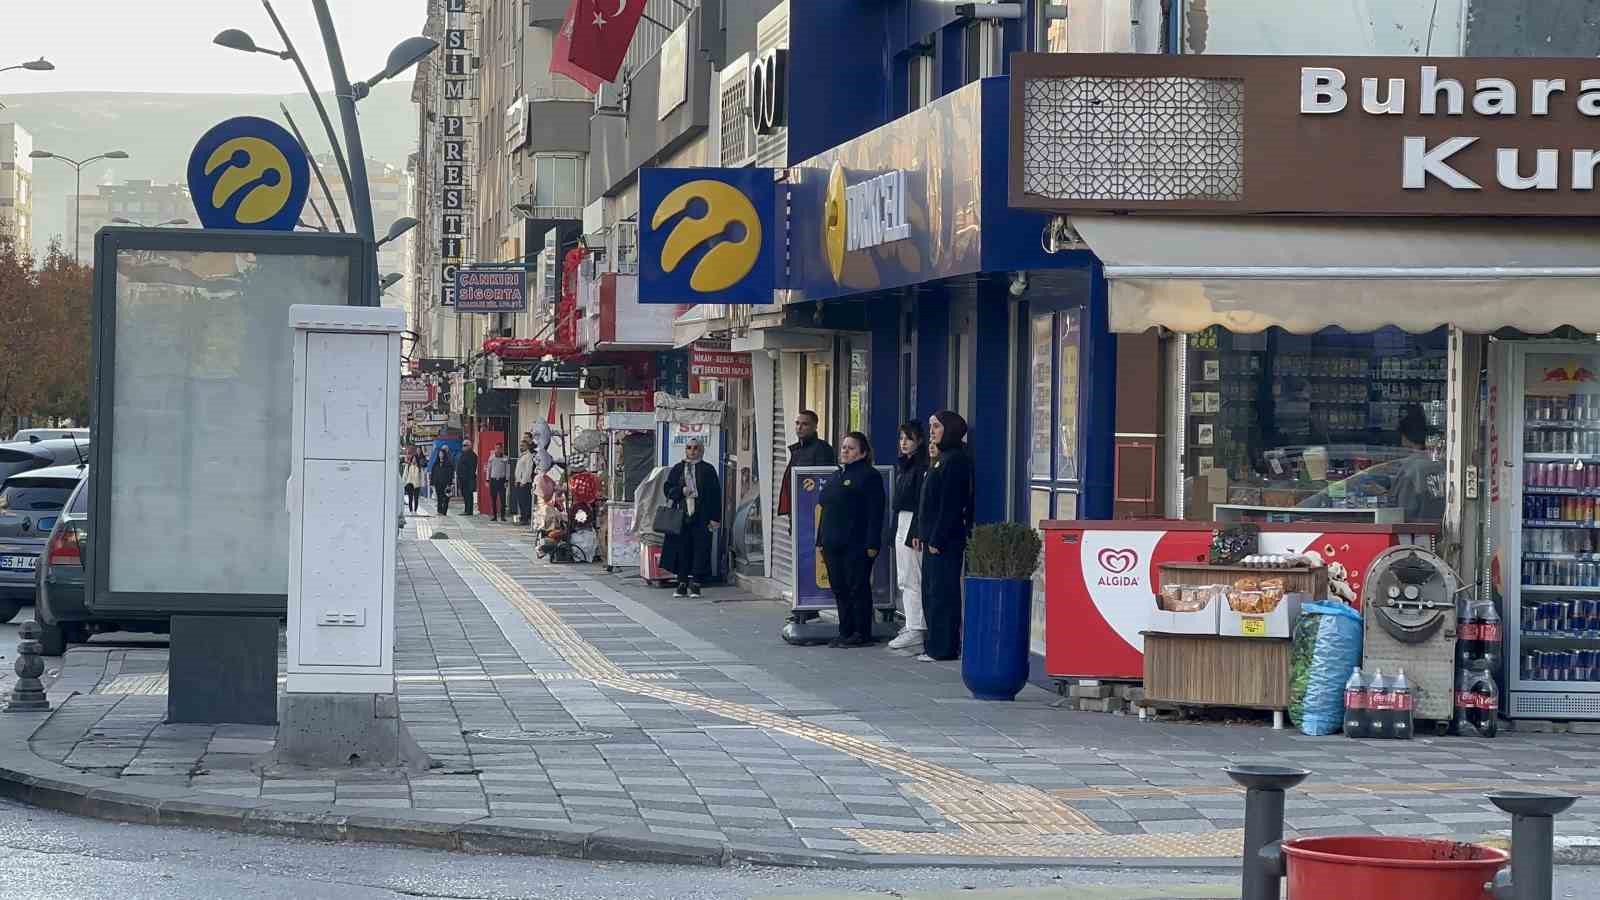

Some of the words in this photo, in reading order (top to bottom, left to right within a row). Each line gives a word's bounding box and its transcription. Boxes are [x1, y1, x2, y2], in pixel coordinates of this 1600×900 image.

[1300, 65, 1600, 116] Buhara
[459, 287, 522, 300] SİGORTA
[1097, 576, 1138, 586] ALGIDA
